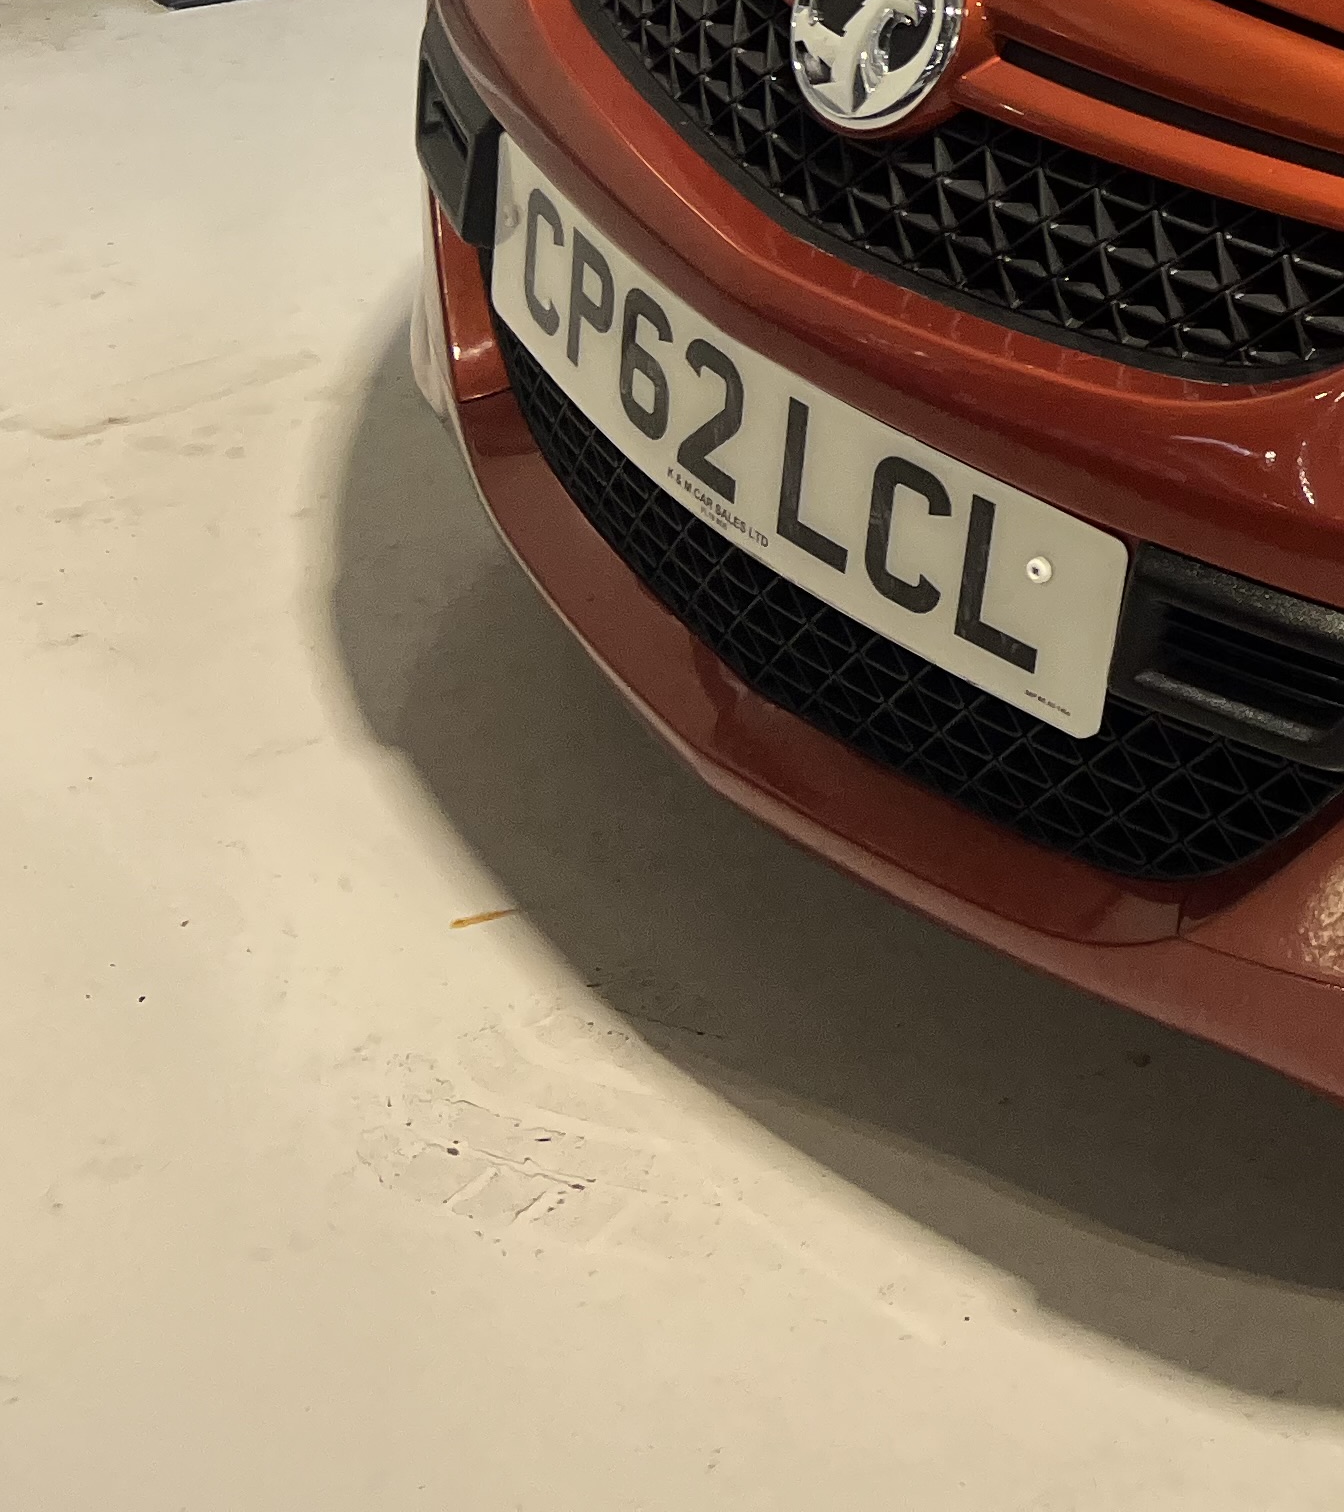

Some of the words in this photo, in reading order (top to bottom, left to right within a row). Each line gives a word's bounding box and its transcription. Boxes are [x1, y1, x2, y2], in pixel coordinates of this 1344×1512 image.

[523, 188, 745, 504] CP62
[776, 396, 1038, 675] LCL
[693, 488, 713, 511] CAR
[715, 503, 746, 534] SALES
[748, 527, 769, 548] LTD
